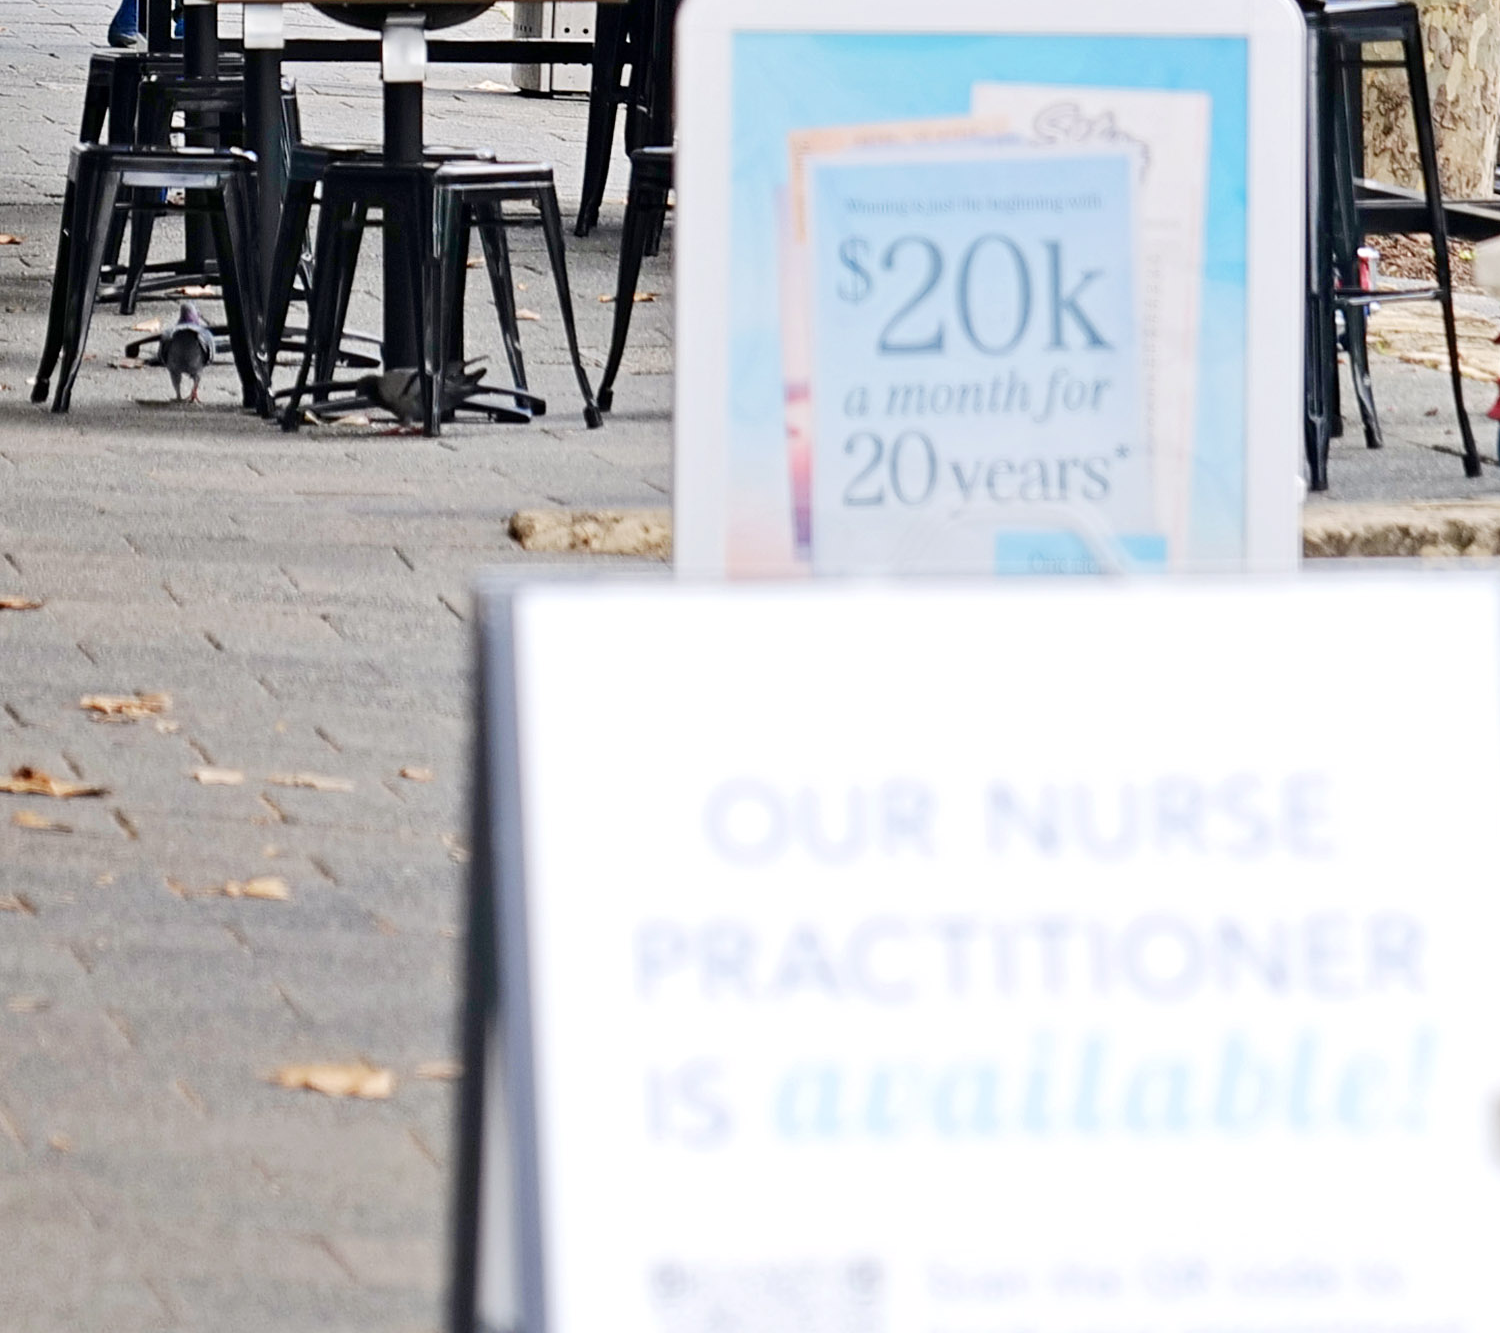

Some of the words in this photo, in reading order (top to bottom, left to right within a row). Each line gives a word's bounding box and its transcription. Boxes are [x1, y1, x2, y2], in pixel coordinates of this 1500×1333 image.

[987, 194, 1065, 216] beginning
[1068, 192, 1103, 211] with
[839, 232, 1117, 357] $20k
[843, 383, 869, 417] a
[885, 370, 1031, 417] month
[1032, 367, 1112, 424] for
[843, 429, 938, 507] 20
[702, 775, 937, 867] OUR
[984, 771, 1337, 861] NURSE
[633, 909, 1428, 1005] PRACTITIONER
[644, 1058, 734, 1151] IS
[776, 1023, 1438, 1144] available!
